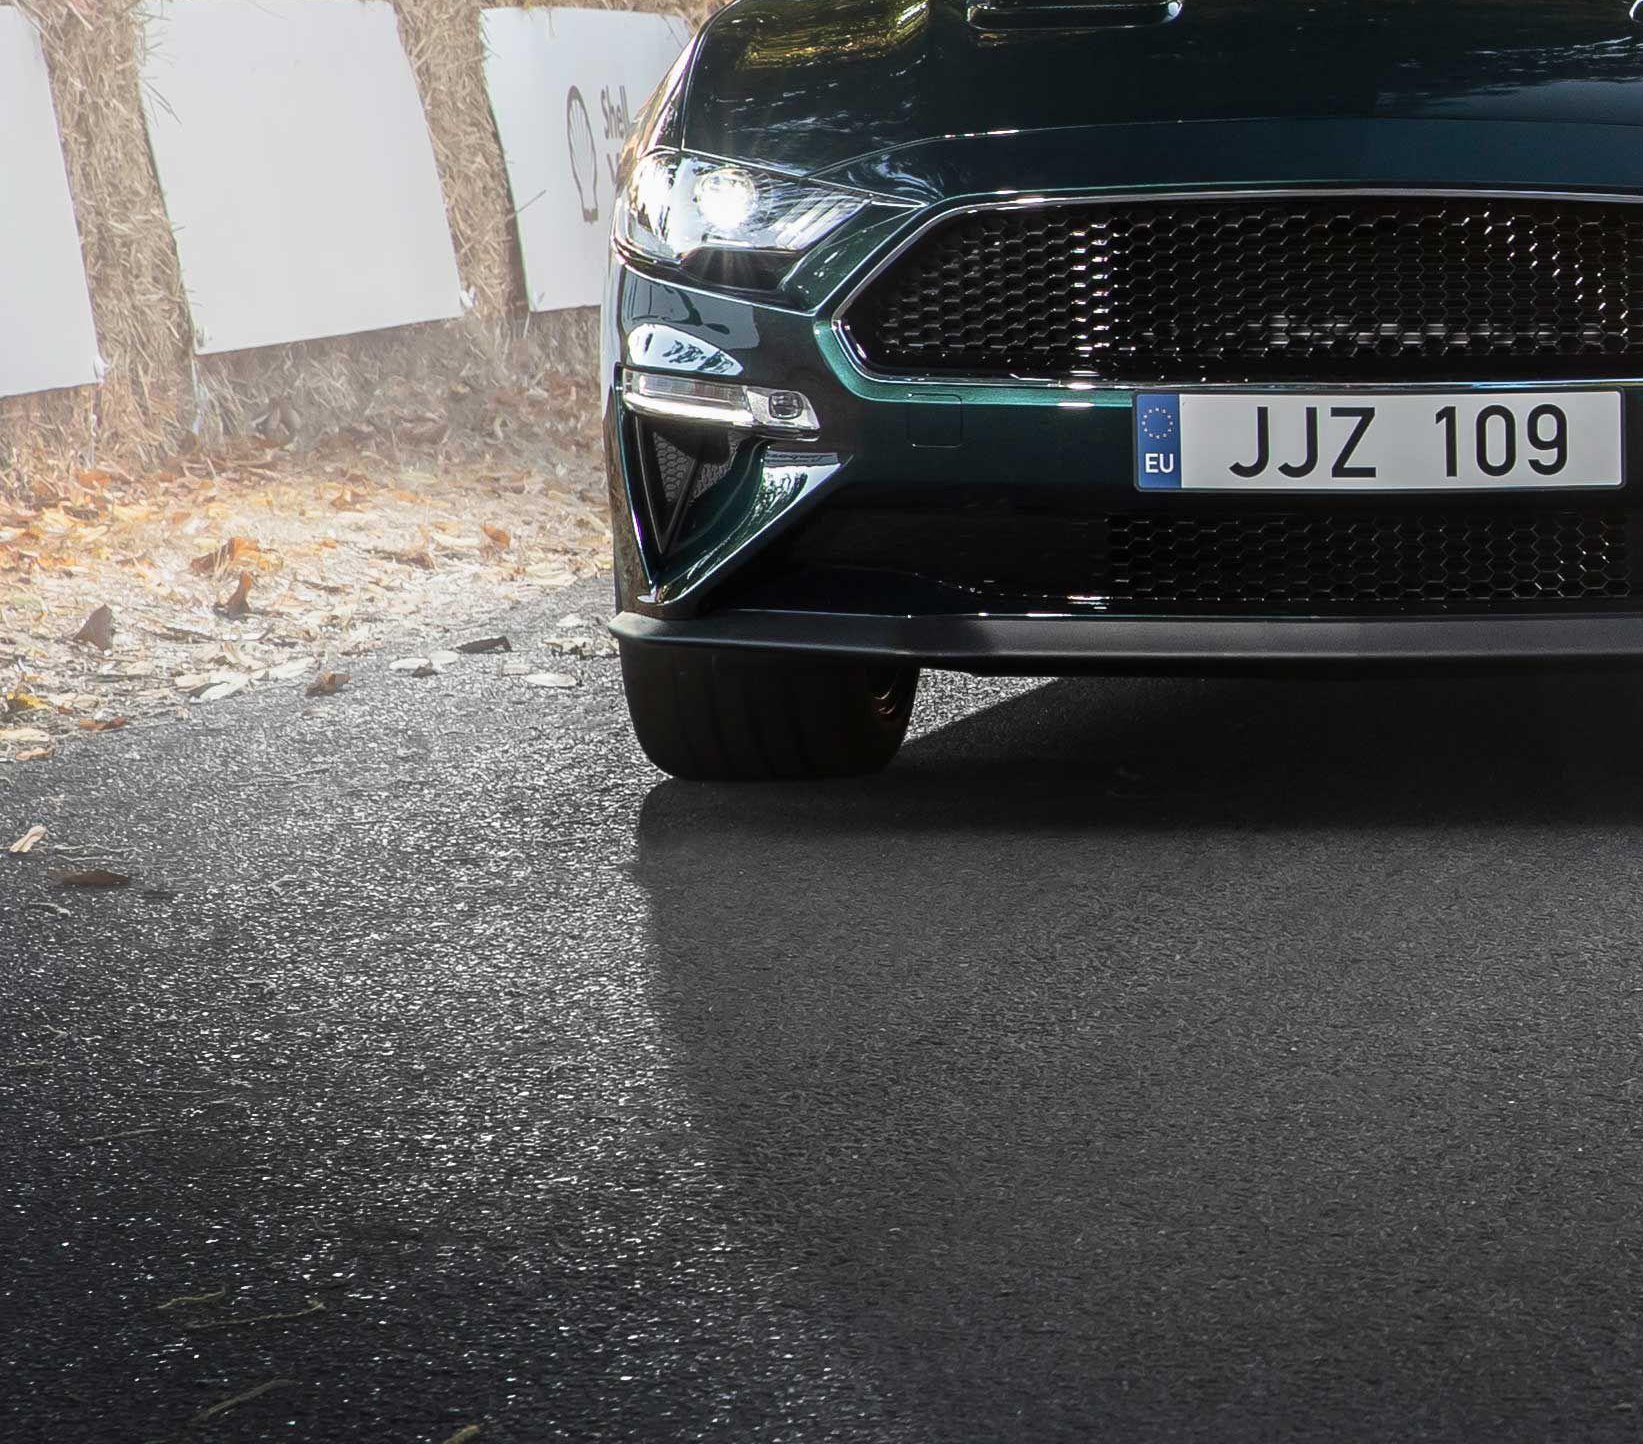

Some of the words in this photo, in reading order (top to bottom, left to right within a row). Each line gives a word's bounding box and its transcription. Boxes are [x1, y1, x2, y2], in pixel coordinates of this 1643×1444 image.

[601, 85, 629, 140] Shell
[1145, 454, 1174, 474] EU
[1228, 405, 1377, 479] JJZ
[1435, 403, 1568, 478] 109
